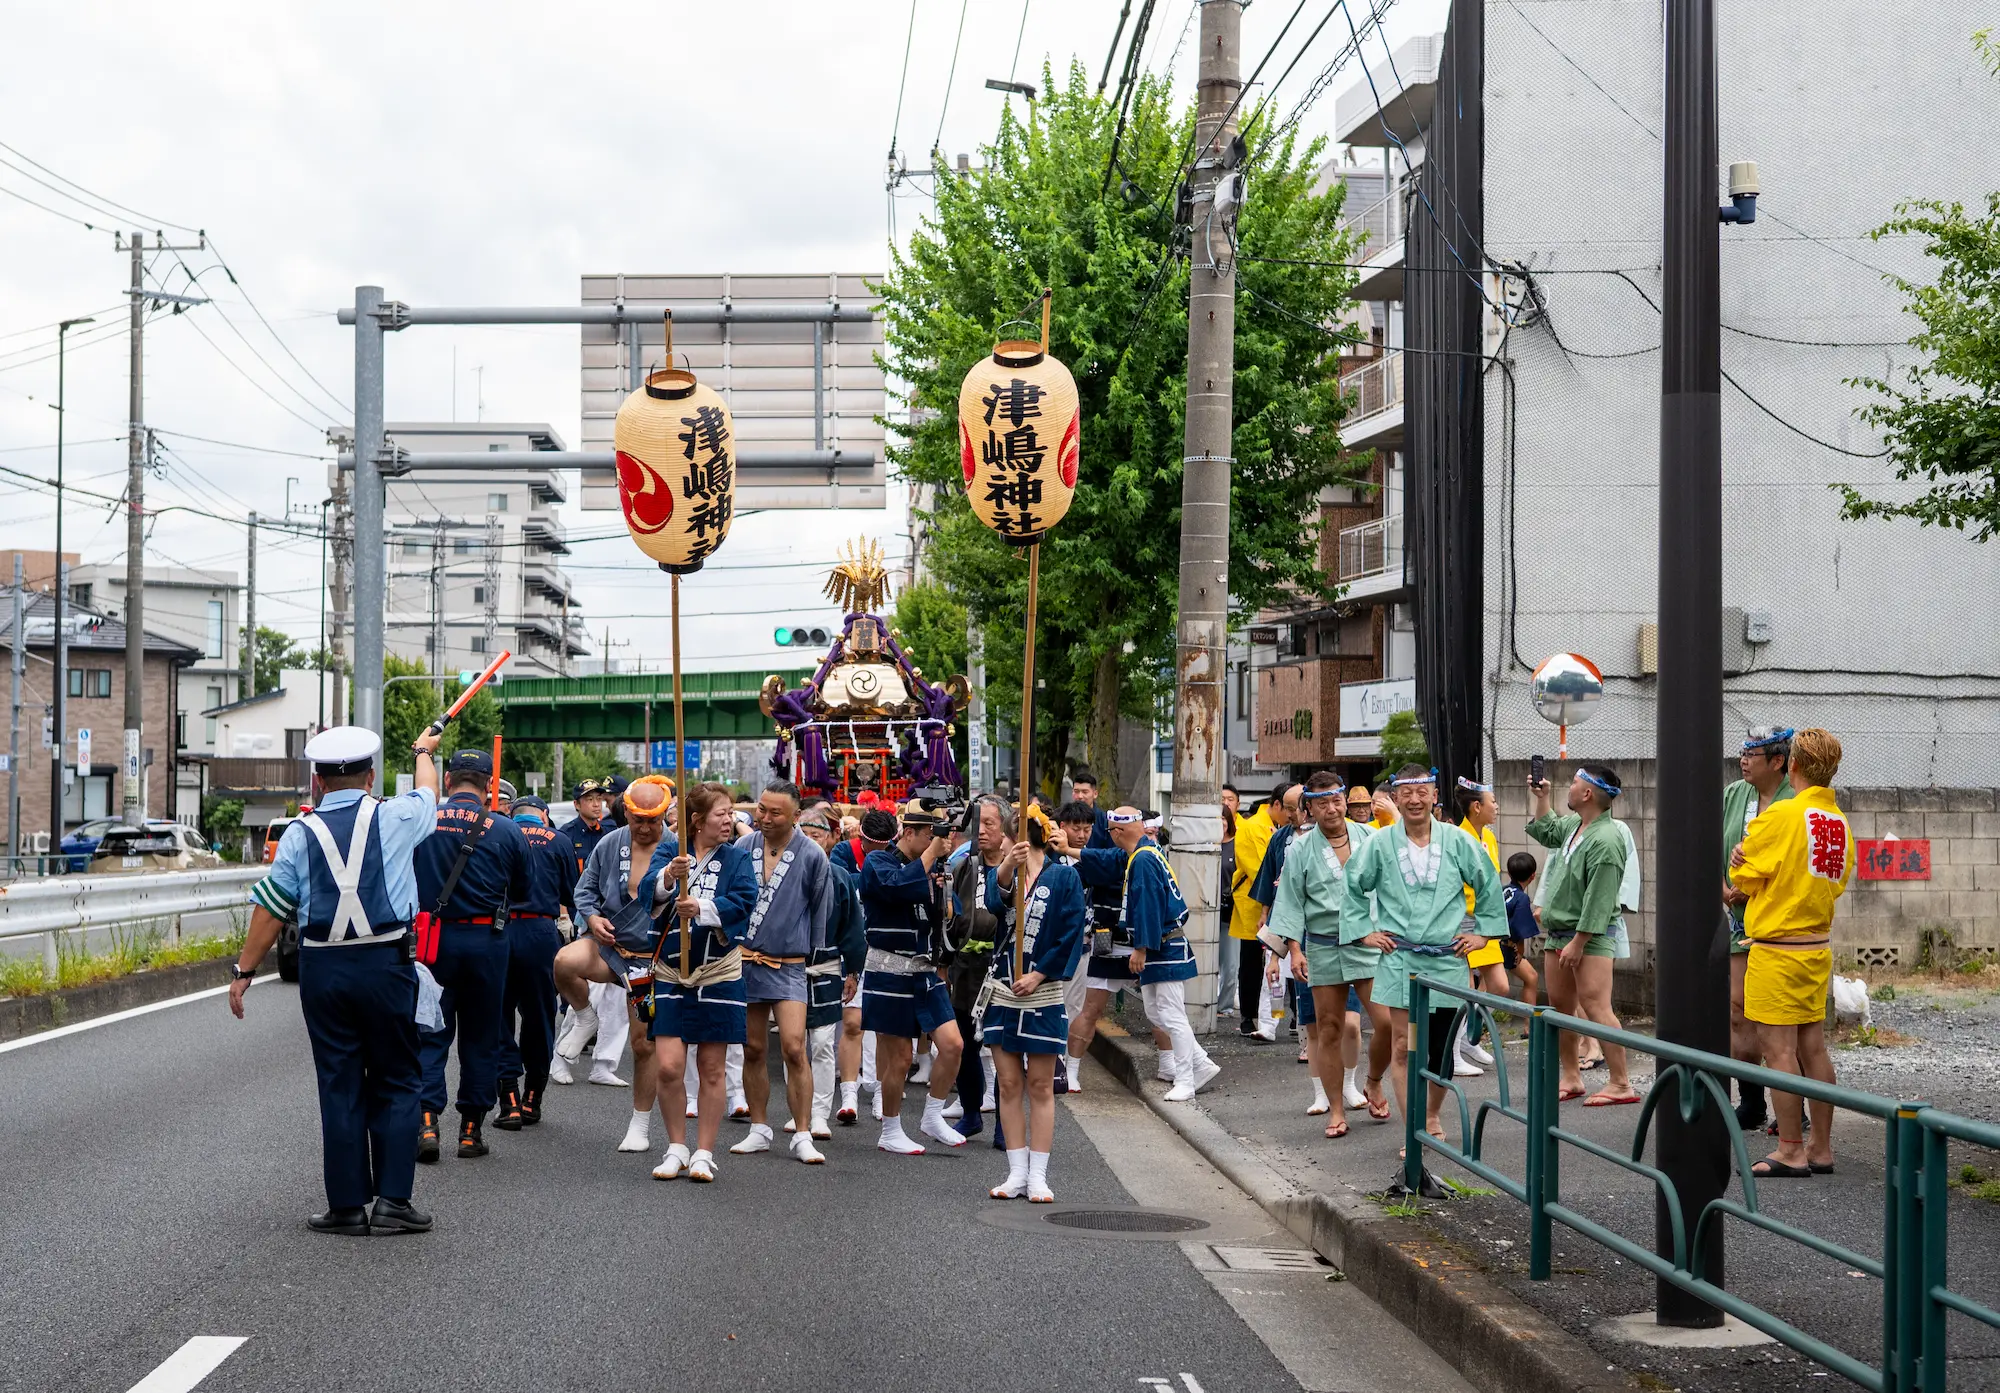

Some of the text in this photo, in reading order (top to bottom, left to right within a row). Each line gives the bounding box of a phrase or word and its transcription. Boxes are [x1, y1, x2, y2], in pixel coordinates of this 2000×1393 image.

[678, 405, 734, 562] 津嶋神社
[982, 378, 1048, 534] 津嶋神社
[436, 809, 494, 830] 東京市消団
